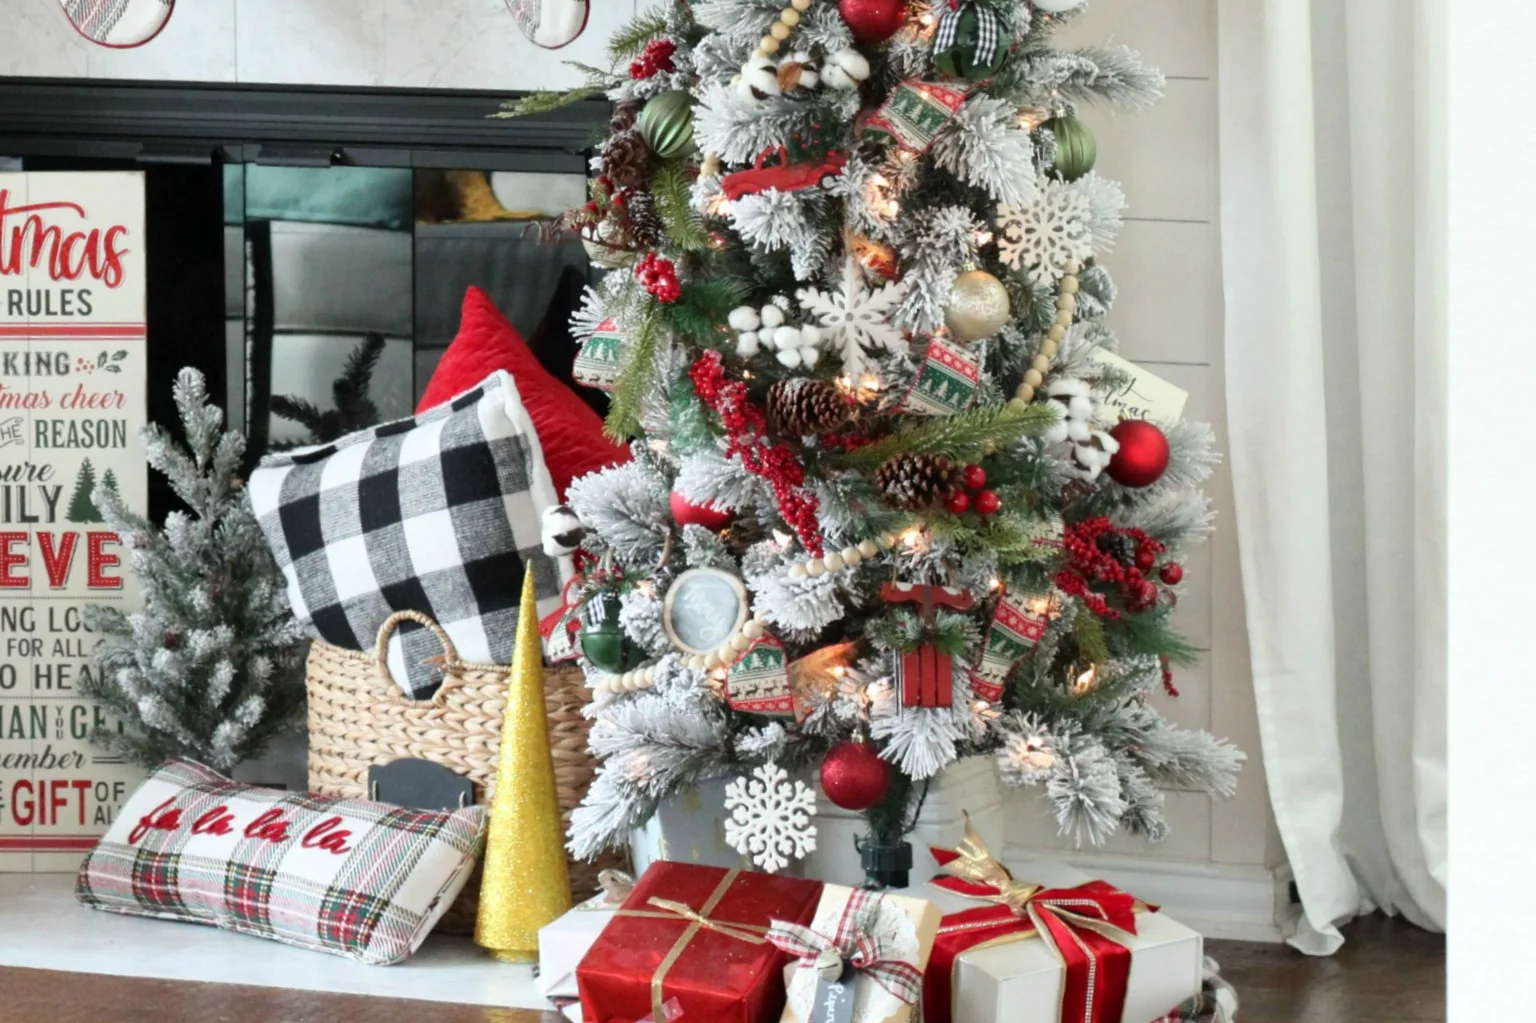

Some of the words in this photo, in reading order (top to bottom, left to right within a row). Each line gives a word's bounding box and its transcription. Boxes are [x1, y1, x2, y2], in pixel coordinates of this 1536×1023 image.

[7, 288, 93, 317] RULES
[59, 382, 126, 410] cheer
[34, 418, 127, 448] REASON
[7, 638, 44, 657] FOR
[52, 638, 88, 657] ALL
[55, 705, 64, 740] YOU
[11, 779, 92, 826] GIFT
[95, 781, 126, 802] OF
[94, 805, 122, 825] AL
[127, 796, 182, 844] fa
[191, 805, 235, 836] la
[244, 808, 290, 843] la
[301, 816, 353, 855] la
